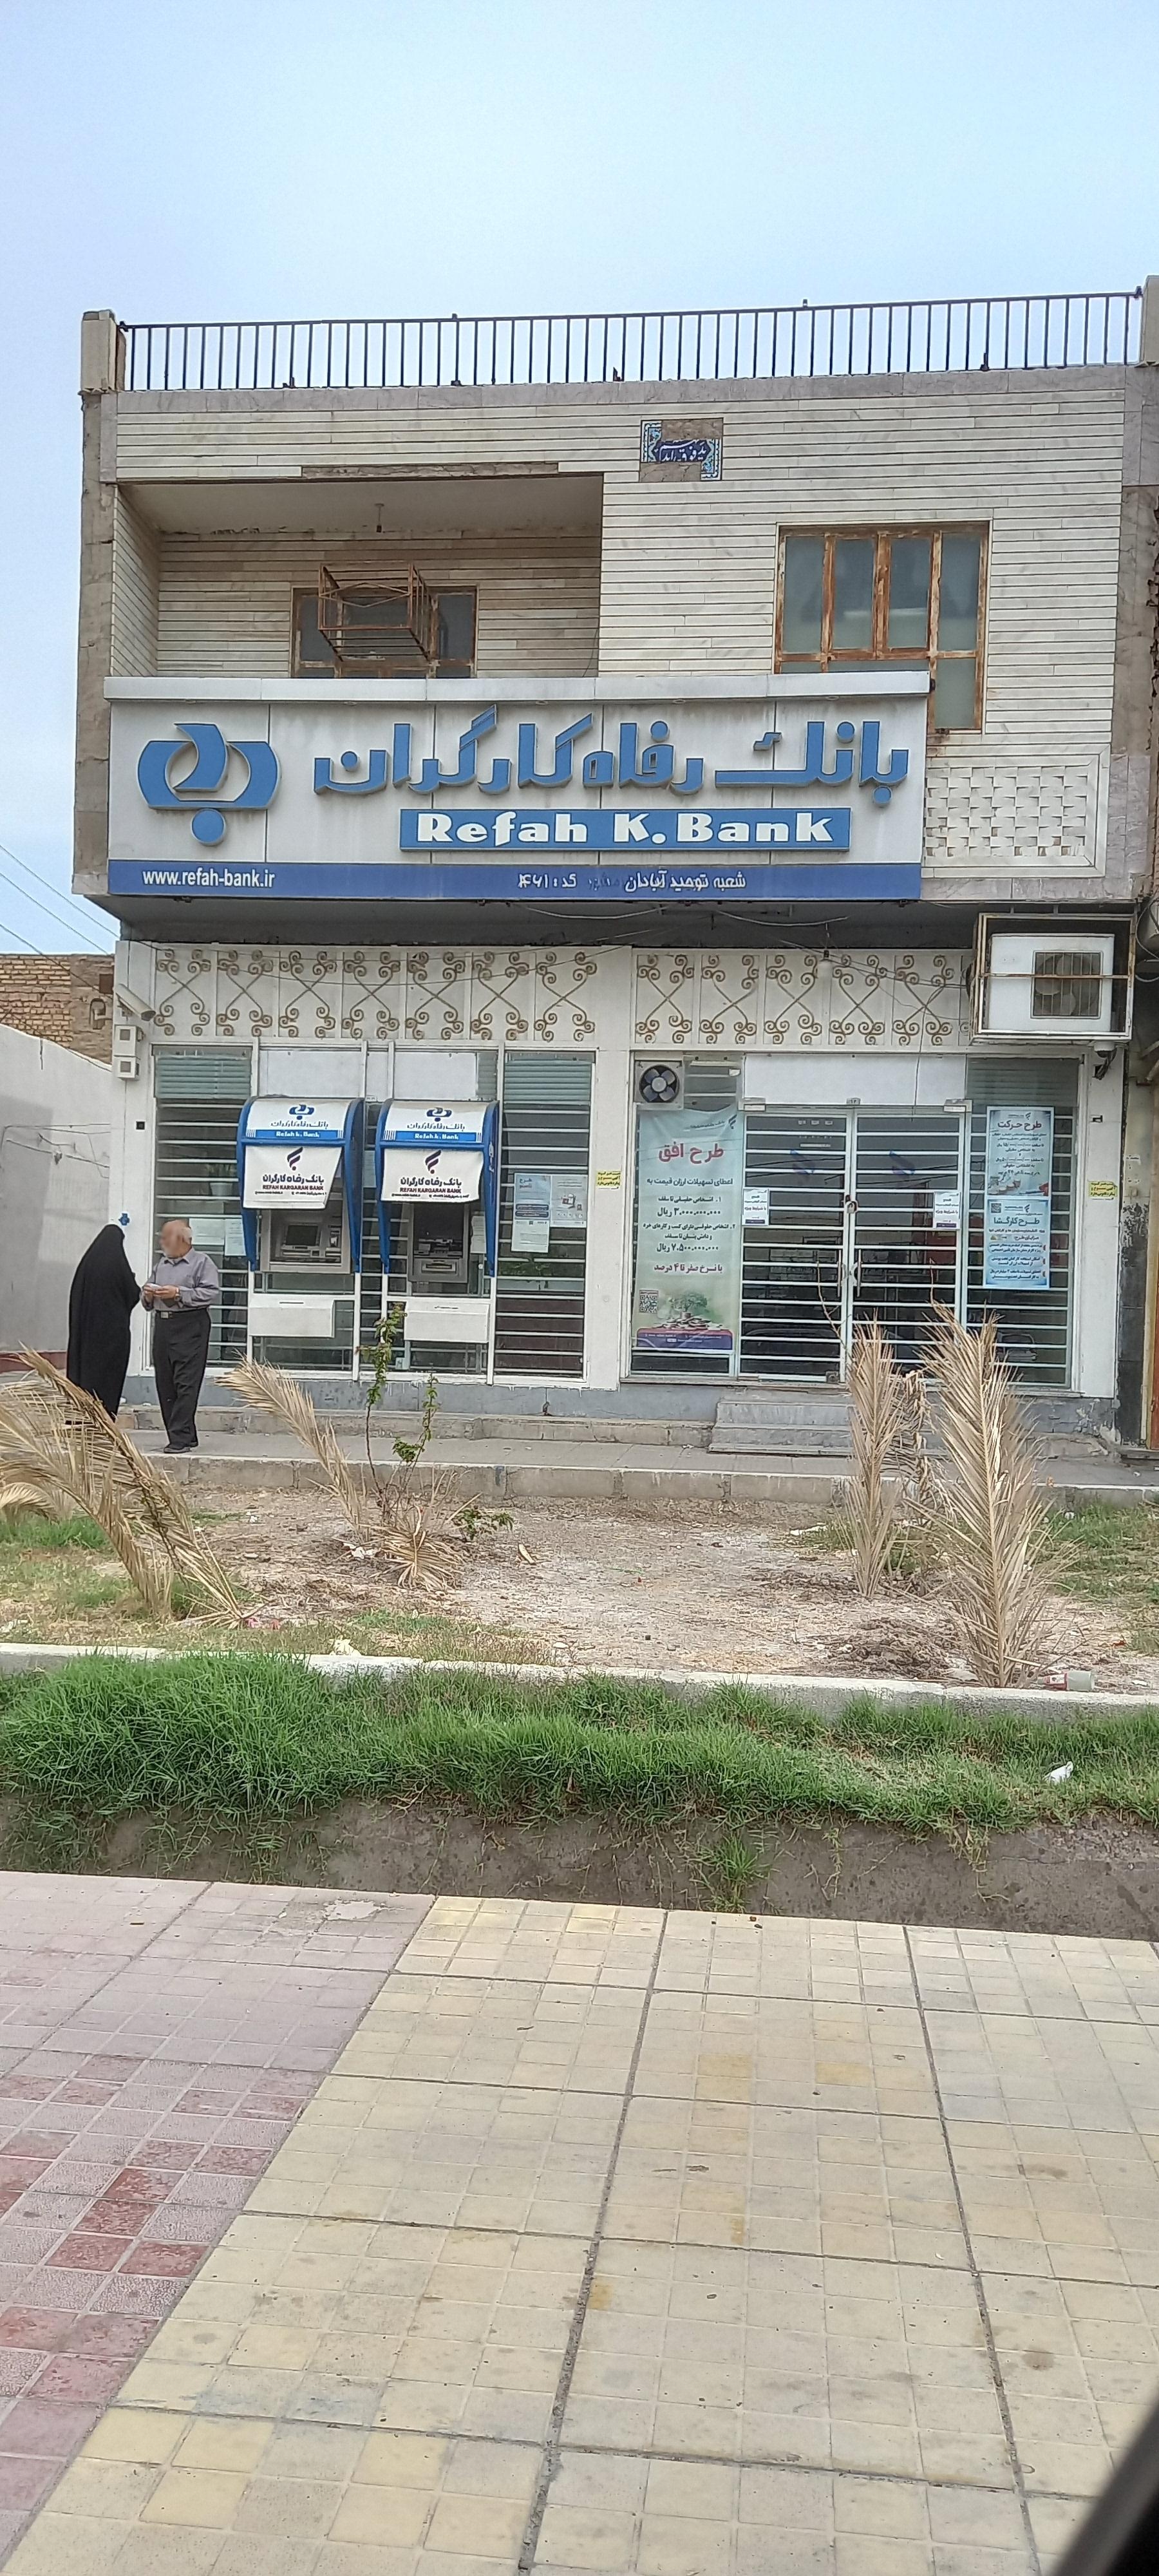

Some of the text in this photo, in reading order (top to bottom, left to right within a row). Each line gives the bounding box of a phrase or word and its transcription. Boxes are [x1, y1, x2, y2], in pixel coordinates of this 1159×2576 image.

[314, 704, 909, 806] بانک رفاه کارگران
[417, 811, 587, 846] Refah
[143, 867, 276, 887] www.refah-bank.ir
[625, 869, 667, 893] آبادان
[670, 873, 709, 891] توحید
[713, 871, 746, 891] شعبه
[997, 1120, 1042, 1132] طرح حرکت
[658, 1142, 724, 1164] طرح افق
[262, 1173, 325, 1186] بانک رفاه کارگران
[400, 1177, 462, 1188] بانک رفاه کارگران
[654, 1177, 672, 1186] قیمت
[673, 1178, 686, 1187] ارزان
[686, 1178, 713, 1187] تسهیلات
[714, 1178, 733, 1187] اعطای
[657, 1207, 672, 1217] ریال
[994, 1217, 1040, 1226] طرح کارگشا
[657, 1243, 670, 1252] ریال
[699, 1264, 717, 1273] نرخ
[717, 1264, 722, 1274] با
